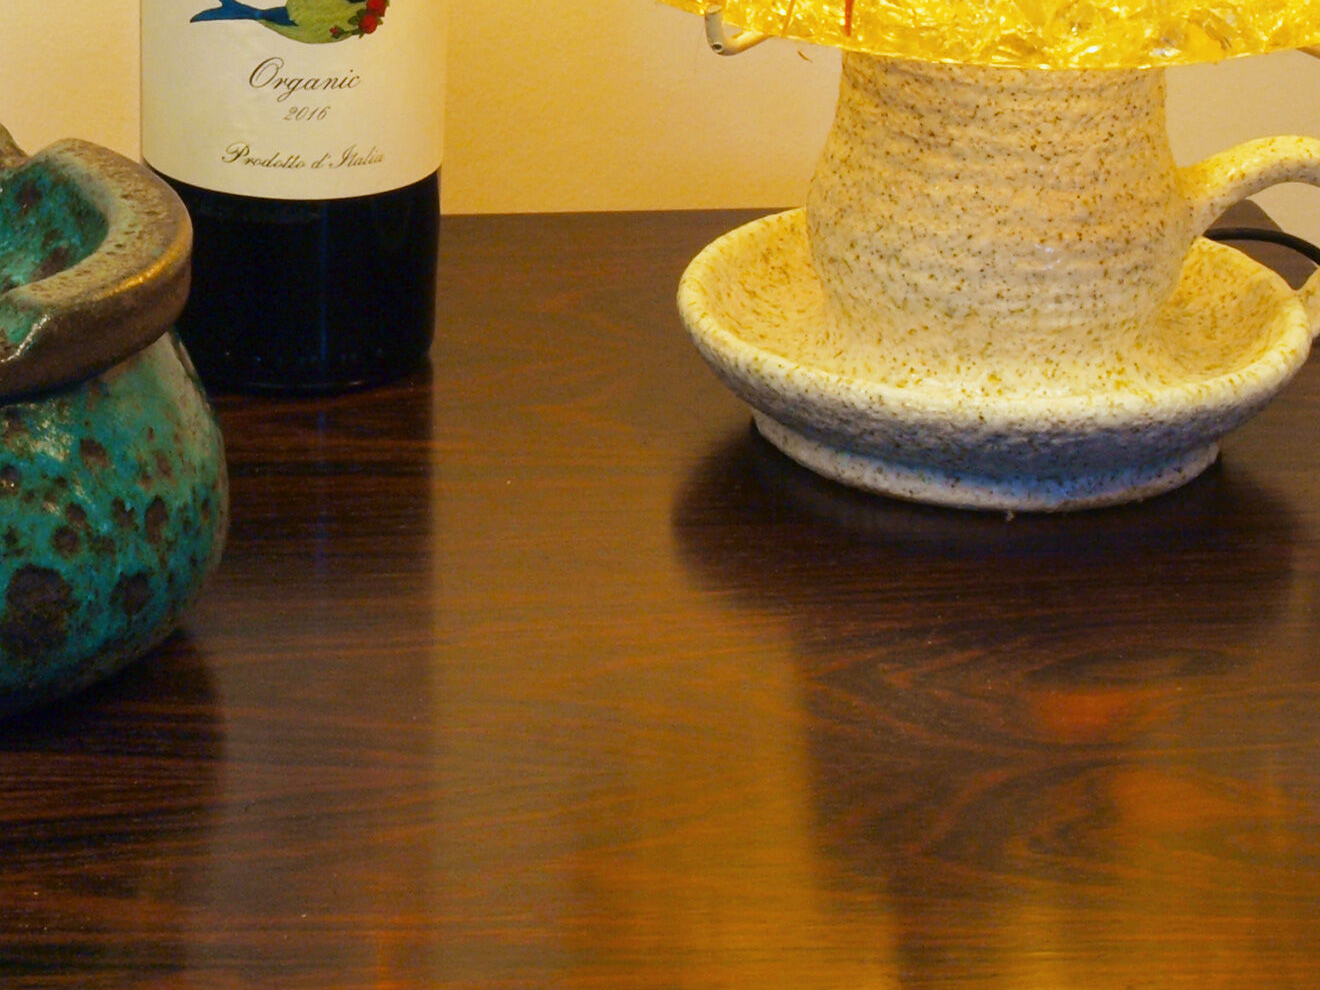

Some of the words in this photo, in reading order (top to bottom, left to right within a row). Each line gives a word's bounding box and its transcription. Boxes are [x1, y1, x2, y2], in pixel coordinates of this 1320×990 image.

[248, 56, 361, 103] Organic
[283, 105, 331, 122] 2016
[221, 141, 306, 170] Prodotto
[329, 144, 385, 169] Italia
